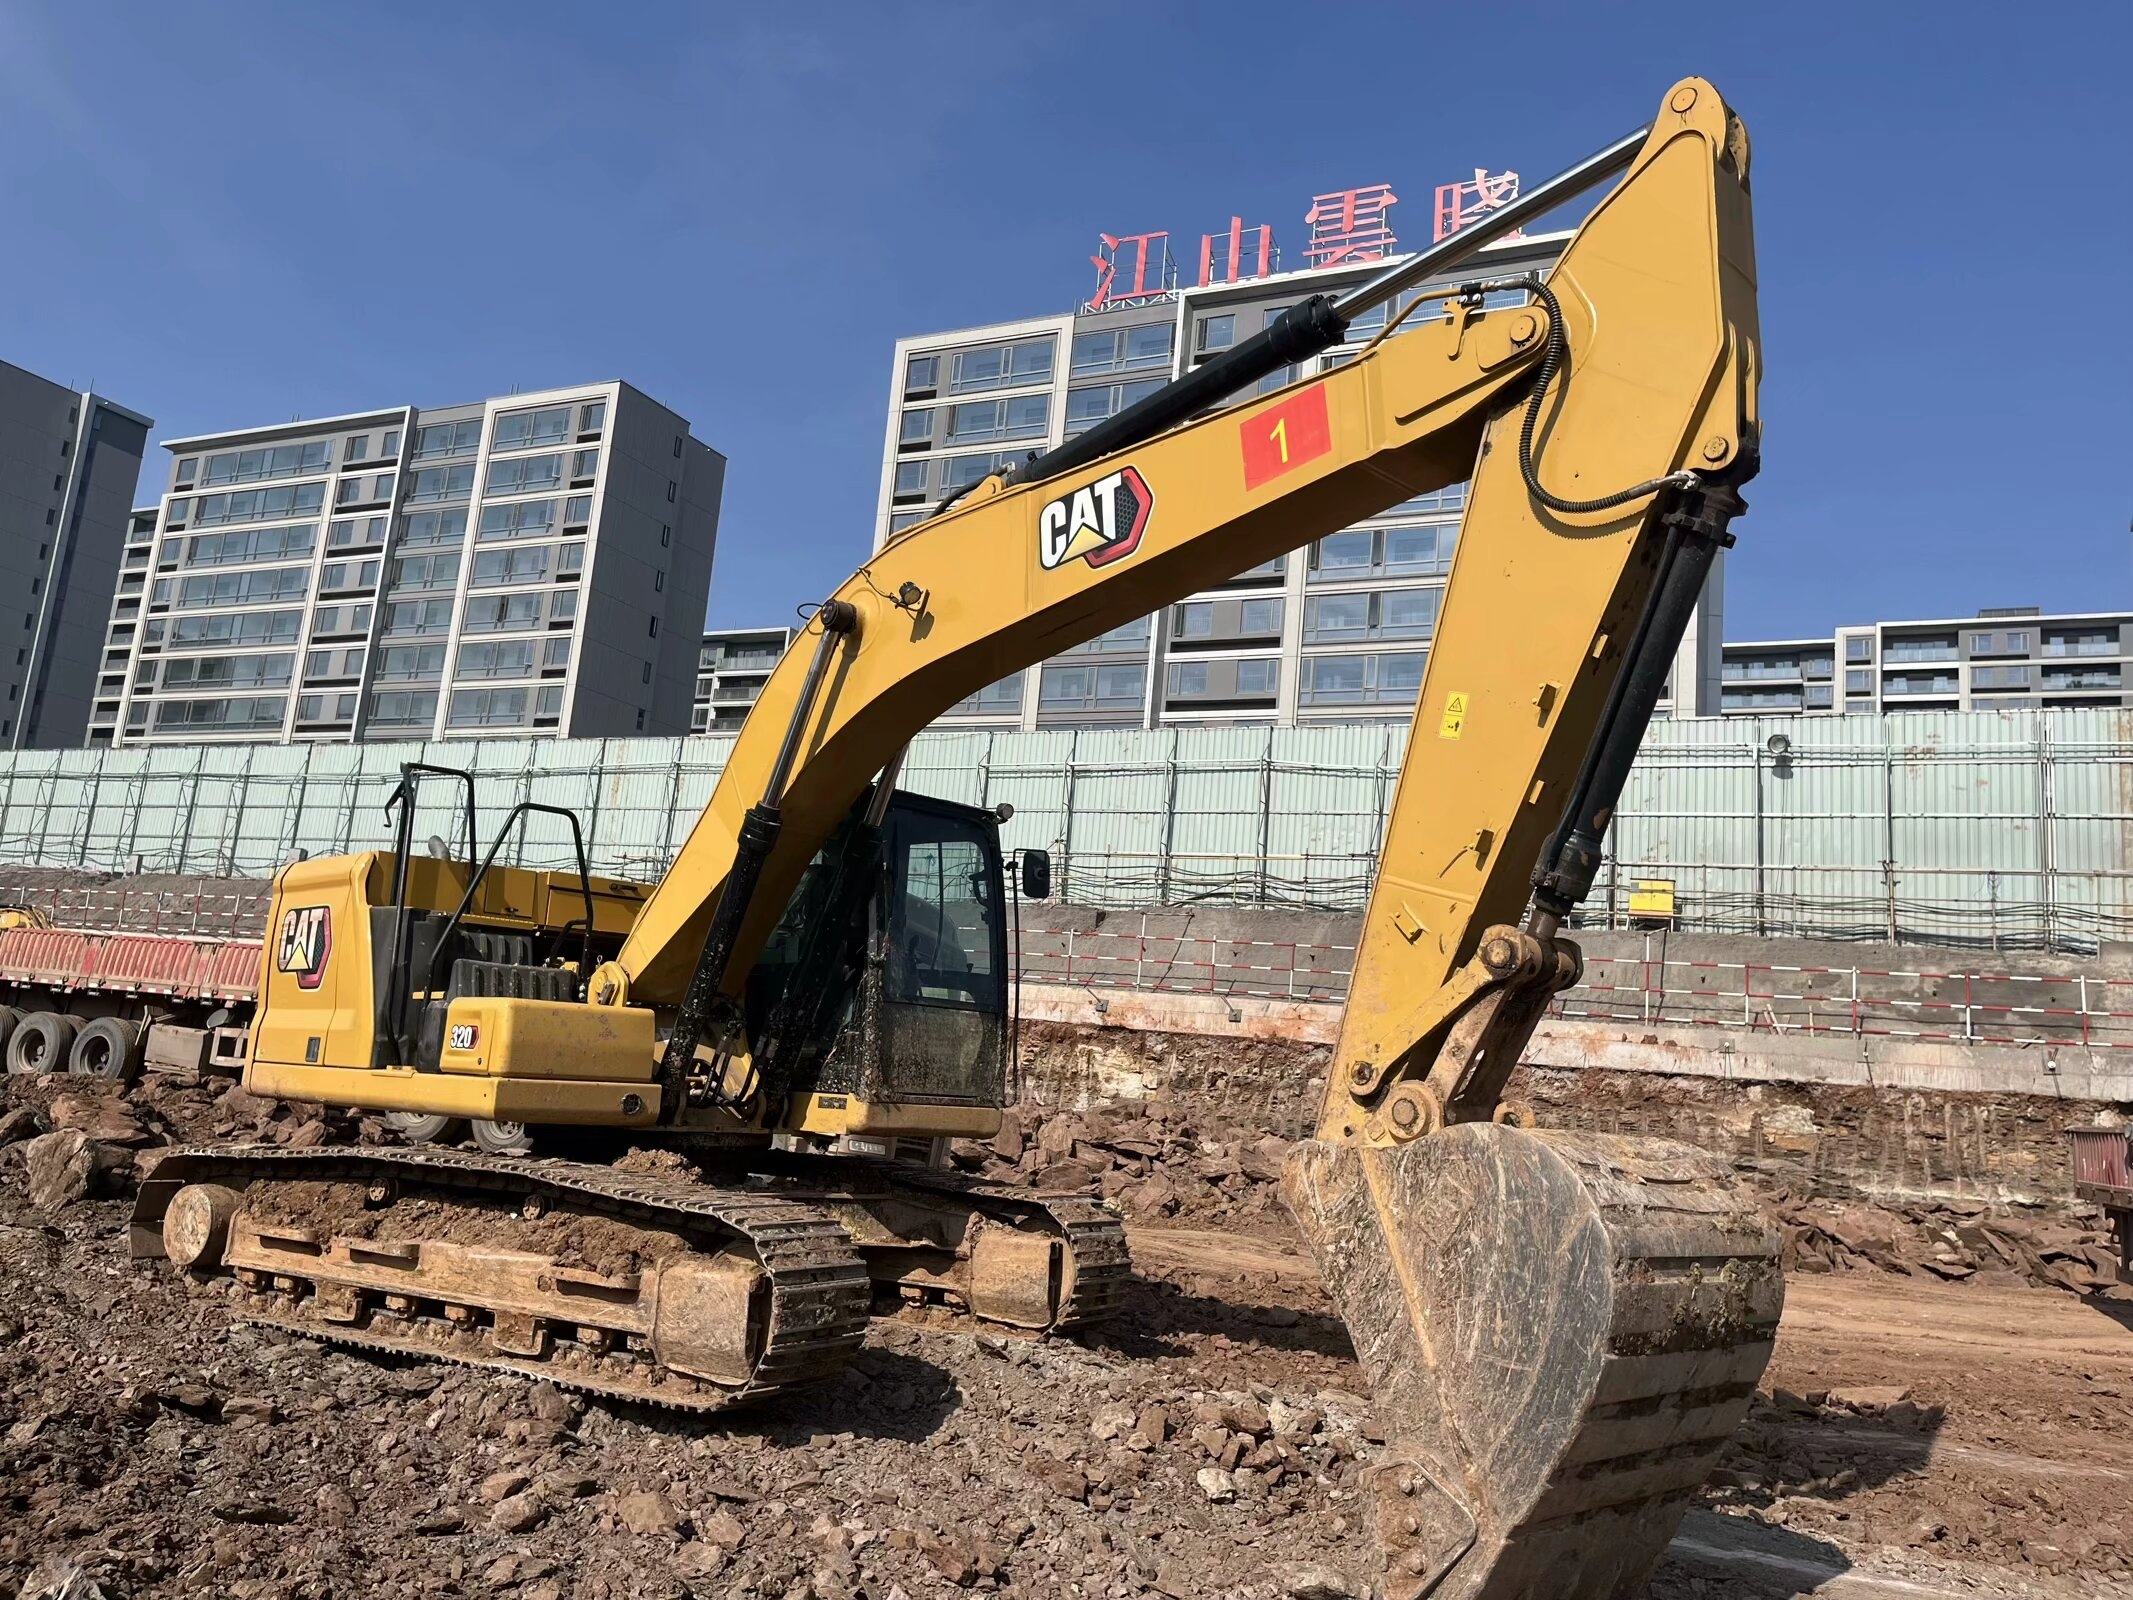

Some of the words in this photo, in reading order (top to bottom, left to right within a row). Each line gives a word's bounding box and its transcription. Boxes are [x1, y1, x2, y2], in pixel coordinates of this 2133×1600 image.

[1269, 417, 1288, 464] 1
[1041, 471, 1122, 568] CAT
[279, 908, 325, 970] CAT
[450, 1025, 473, 1048] 320
